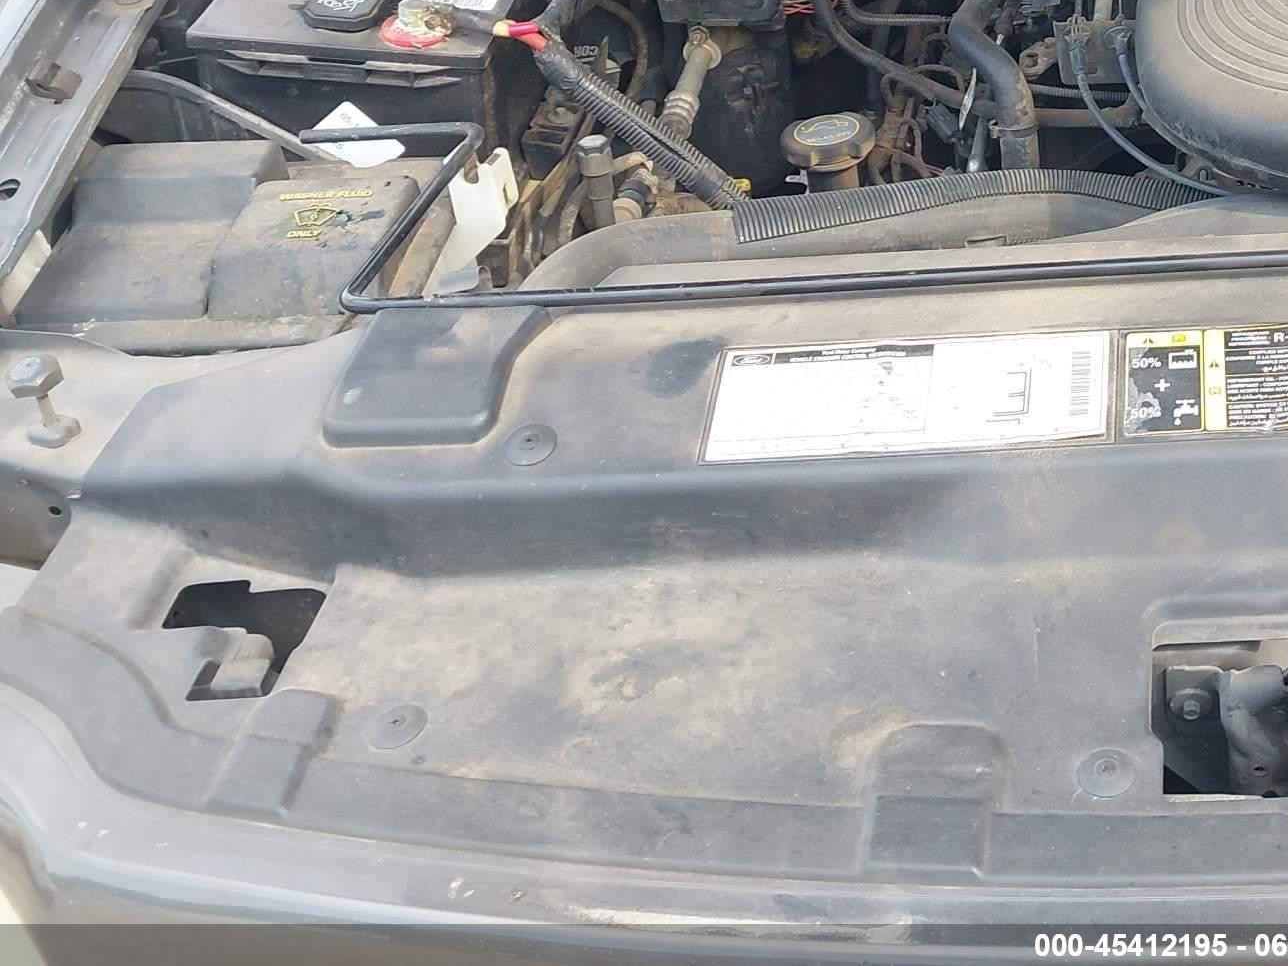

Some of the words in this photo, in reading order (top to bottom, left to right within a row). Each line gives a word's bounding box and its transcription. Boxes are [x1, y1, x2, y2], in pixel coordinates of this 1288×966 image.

[280, 191, 335, 201] WASHER
[336, 189, 374, 199] FLUID
[287, 229, 323, 239] ONLY
[1132, 357, 1162, 368] 50%
[1130, 407, 1162, 418] 50%
